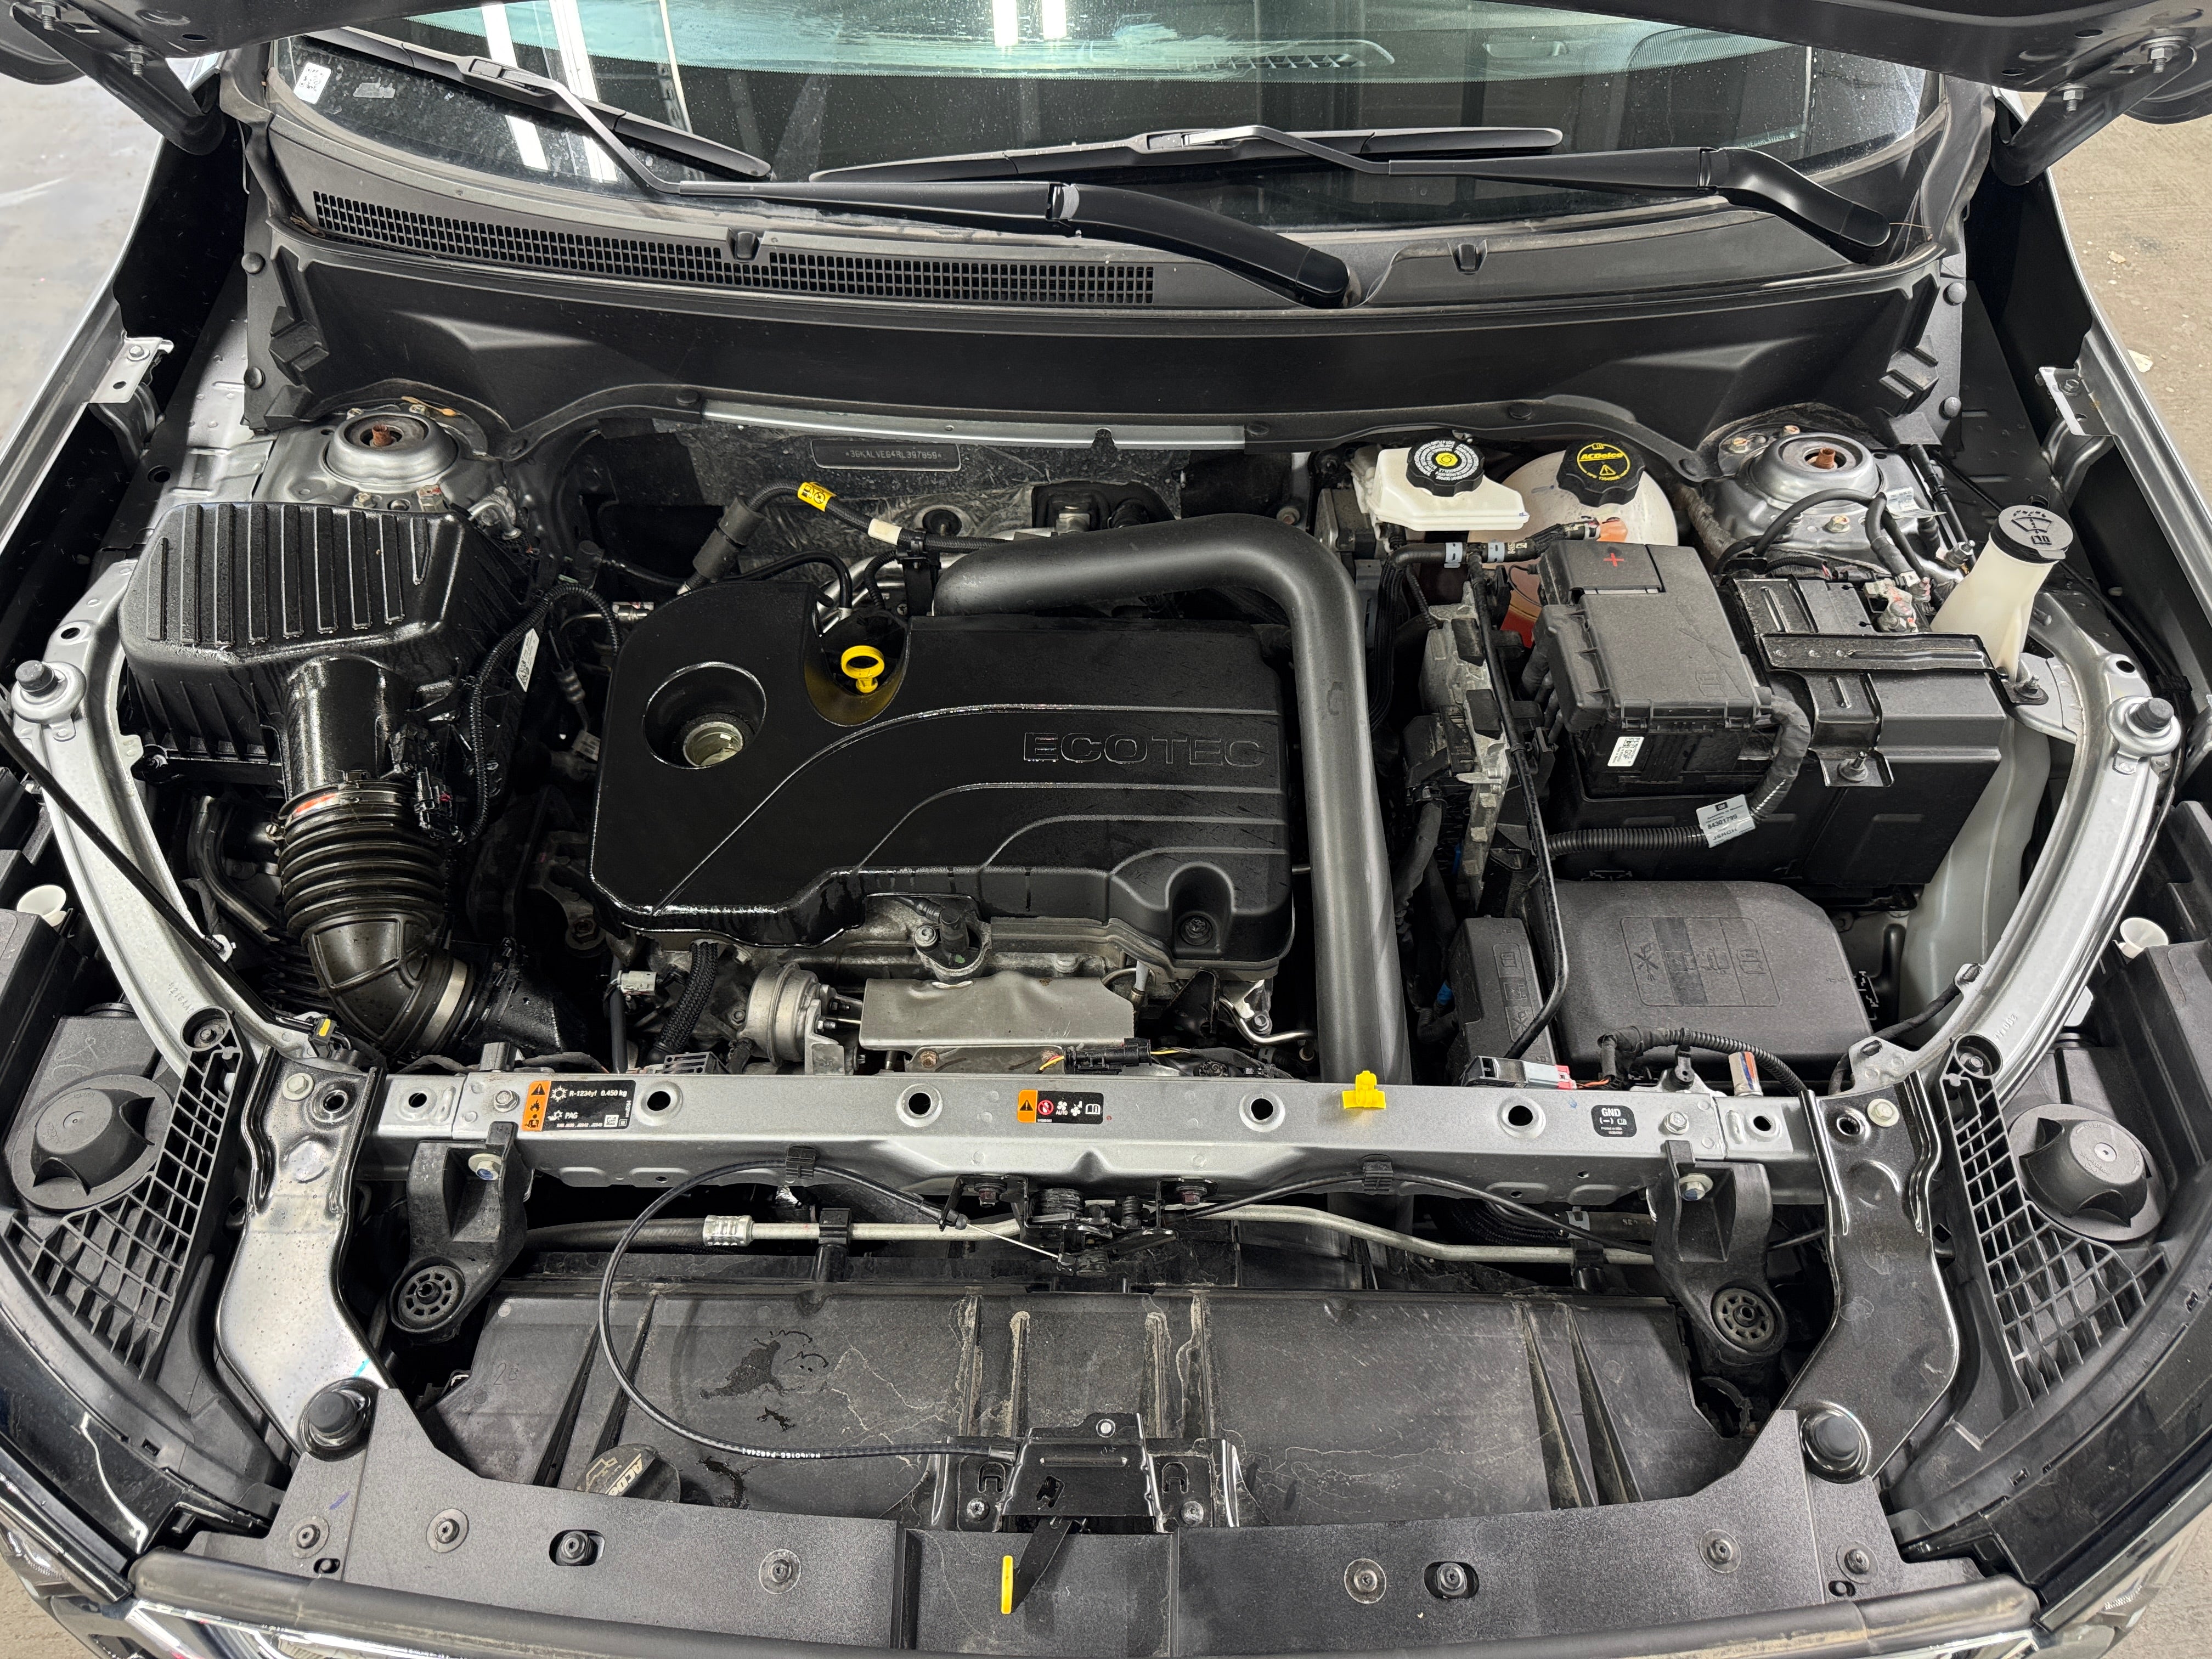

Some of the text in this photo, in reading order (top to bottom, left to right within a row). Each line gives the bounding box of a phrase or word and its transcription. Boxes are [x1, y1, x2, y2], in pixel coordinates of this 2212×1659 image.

[1581, 452, 1623, 460] ACDelco
[1023, 732, 1266, 768] ECOTEC
[1707, 814, 1737, 829] 84301795
[1601, 1108, 1621, 1117] GND
